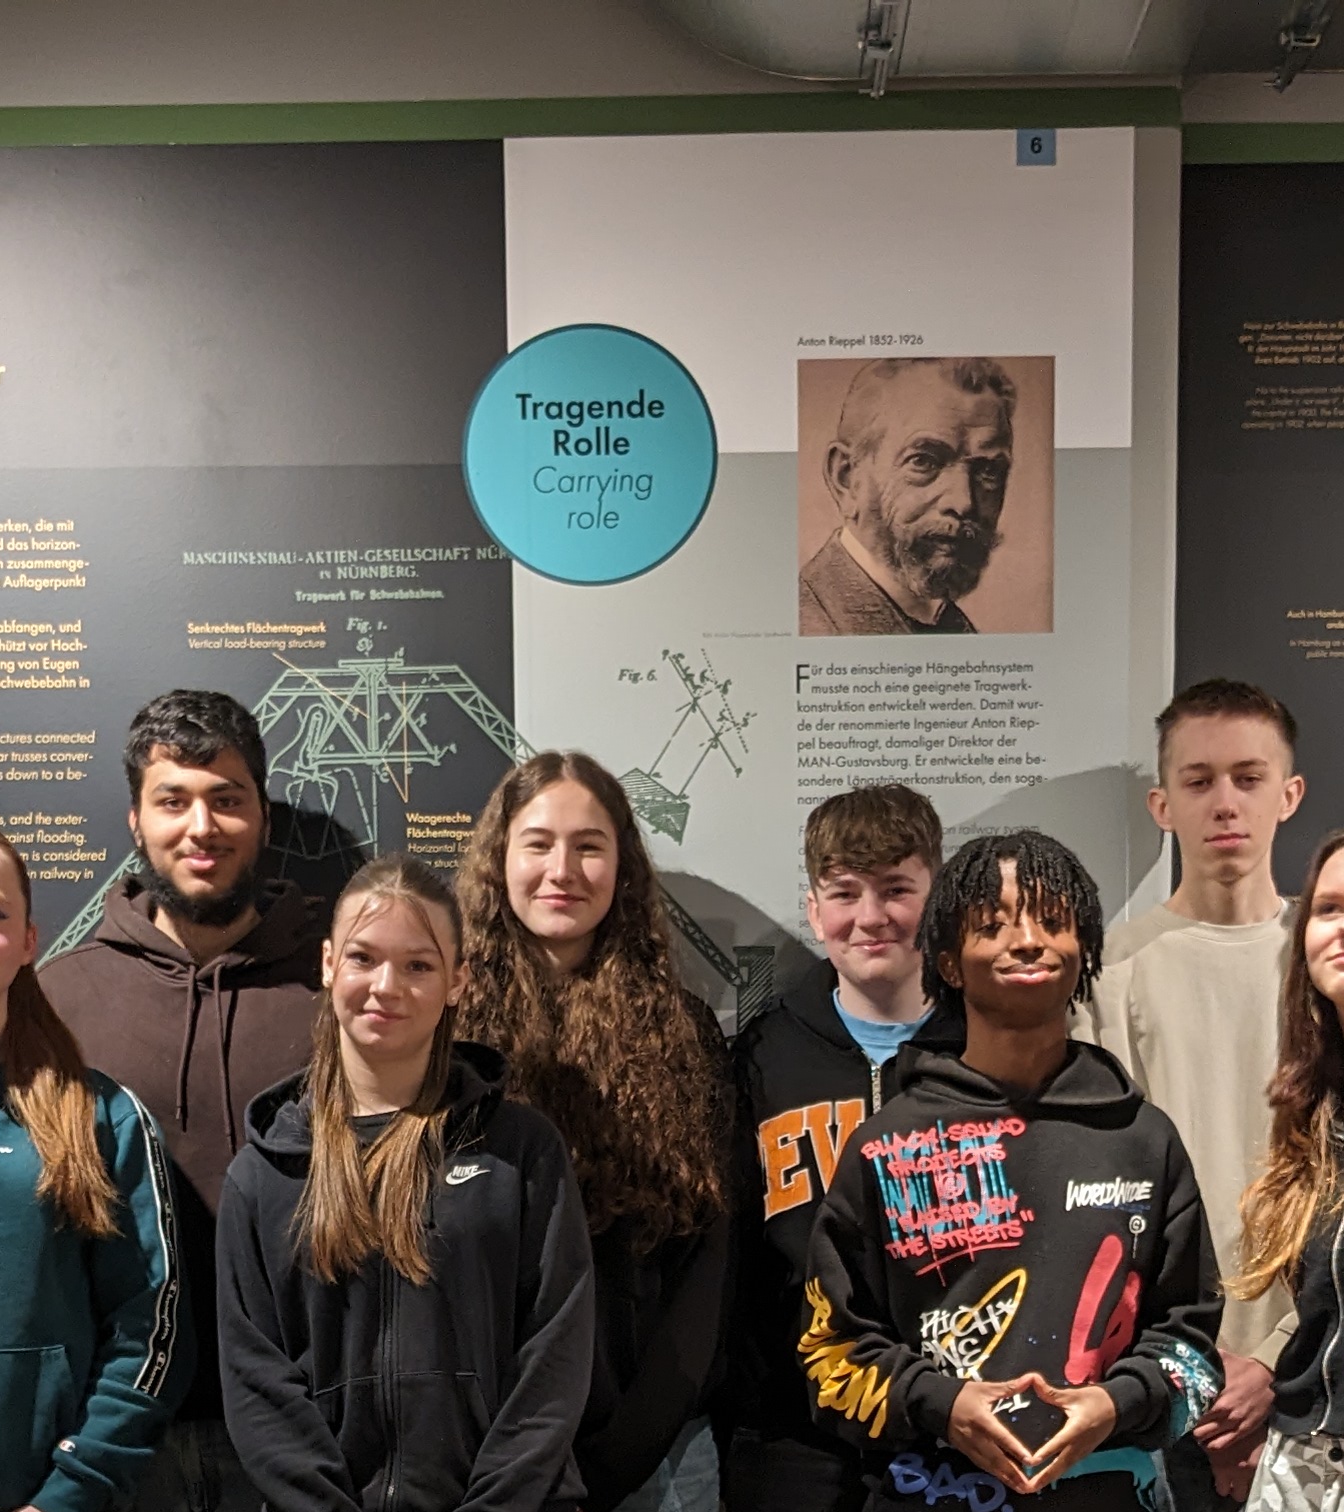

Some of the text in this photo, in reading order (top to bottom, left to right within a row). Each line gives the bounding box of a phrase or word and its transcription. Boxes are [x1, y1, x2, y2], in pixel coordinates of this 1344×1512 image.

[1031, 137, 1042, 154] 6
[797, 334, 924, 349] Anton Rieppel 1852-1926
[516, 390, 665, 426] Tragende
[554, 427, 631, 457] Rolle
[533, 465, 654, 500] Carrying
[567, 500, 620, 531] role
[34, 518, 53, 532] die
[56, 518, 74, 532] mit
[6, 537, 28, 550] das
[30, 536, 80, 550] horizon-
[6, 560, 90, 573] zusammenge-
[187, 622, 328, 637] Senkrechtes Flächentragwerk
[188, 638, 223, 649] Vertical
[288, 639, 327, 649] structure
[825, 663, 847, 675] das
[850, 662, 922, 678] einschienige
[925, 661, 1033, 677] Hängebahnsystem
[811, 679, 1032, 696] musste noch eine geeignete Tragwerk-
[796, 698, 1044, 713] konstruktion entwickelt werden. Damit wur-
[452, 1165, 479, 1178] NIKE
